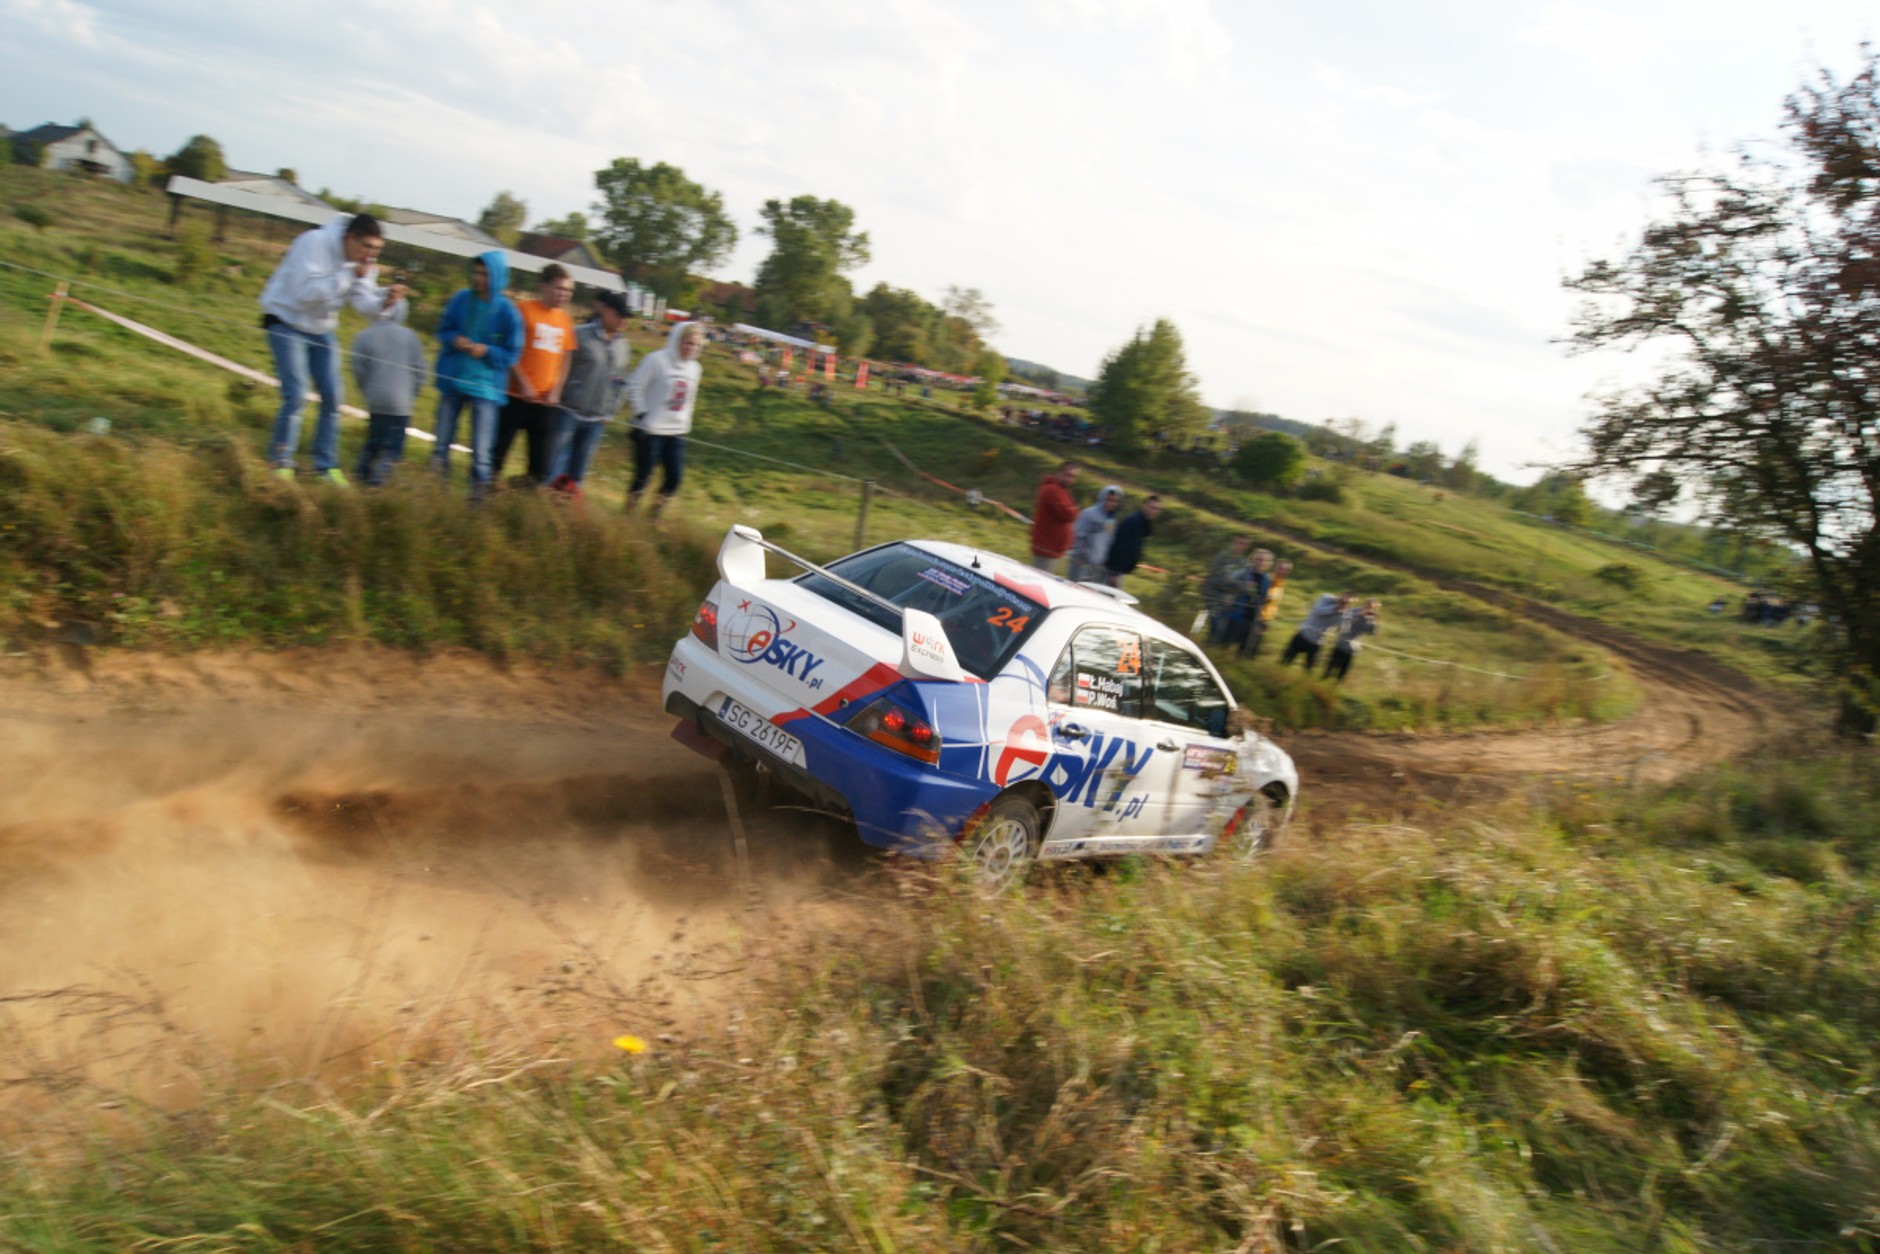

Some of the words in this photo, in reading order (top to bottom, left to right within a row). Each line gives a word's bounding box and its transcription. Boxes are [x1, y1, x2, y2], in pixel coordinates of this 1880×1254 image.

[987, 607, 1031, 635] 24
[729, 705, 752, 729] SG
[751, 719, 798, 755] 2619F
